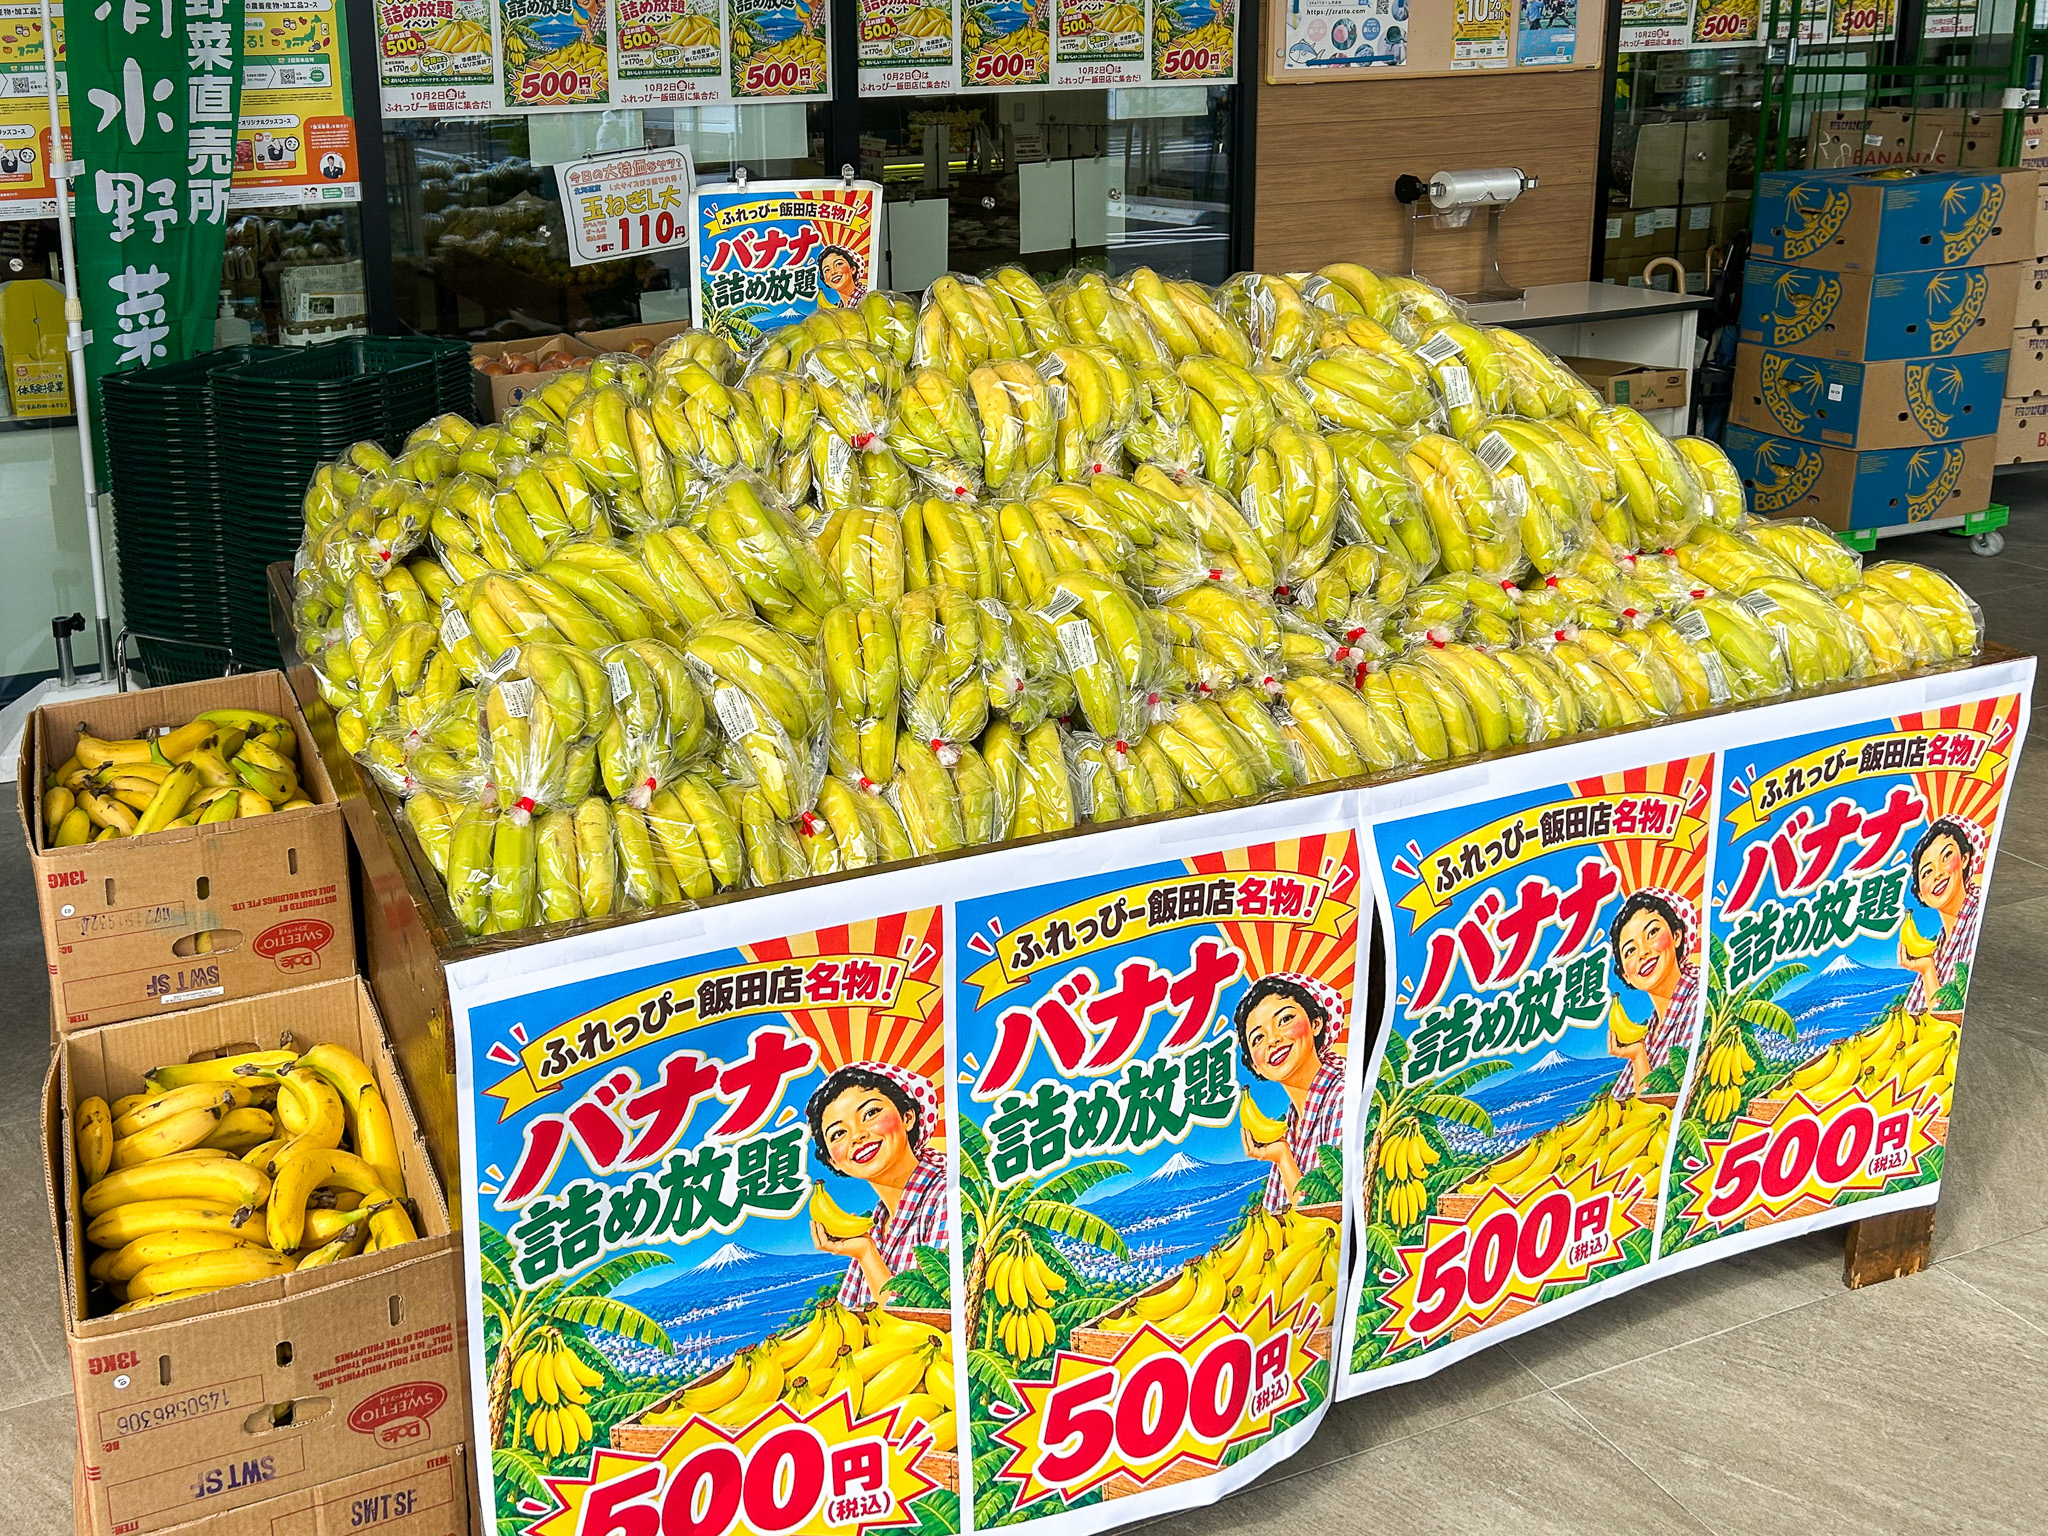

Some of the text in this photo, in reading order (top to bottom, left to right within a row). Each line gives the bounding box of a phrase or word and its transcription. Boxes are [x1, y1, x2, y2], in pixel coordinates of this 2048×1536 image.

[382, 1, 454, 26] 詰め放題
[402, 19, 439, 29] イベント
[620, 0, 686, 21] 詰め放題
[639, 13, 672, 23] イベント
[879, 5, 910, 15] イベント
[864, 22, 897, 40] 500円
[1062, 18, 1093, 35] 500円
[1702, 13, 1748, 37] 500円
[386, 38, 425, 56] 500円
[623, 31, 658, 49] 500円
[975, 53, 1035, 79] 500円
[1163, 48, 1220, 73] 500円
[520, 70, 591, 98] 500円
[746, 62, 811, 90] 500円
[580, 184, 682, 223] 玉ねぎL大
[721, 201, 853, 226] ふれっぴー飯田店名物!
[618, 211, 686, 252] 110円
[1783, 191, 1850, 260] BanaBay
[1944, 183, 2004, 265] BanaBay
[709, 226, 821, 272] バナナ
[713, 265, 819, 308] 詰め放題
[1773, 279, 1841, 346] BanaBay
[1930, 273, 1988, 353] BanaBay
[1760, 353, 1805, 435] BanaBay
[1906, 365, 1949, 439] BanaBay
[1753, 451, 1824, 512] BanaBay
[1907, 448, 1964, 524] BanaBay
[1759, 734, 1986, 810] ふれっぴー飯田店名物!
[1436, 798, 1678, 893] ふれっぴー飯田店名物!
[1723, 789, 1925, 915] バナナ
[47, 870, 88, 889] 13KG
[300, 888, 317, 899] ASIA
[319, 884, 336, 896] DOLE
[262, 892, 300, 906] HOLDINGS
[279, 895, 337, 913] DISTRIBUTED BY
[1011, 878, 1321, 969] ふれっぴー飯田店名物!
[1411, 862, 1618, 1012] バナナ
[1727, 867, 1908, 990] 詰め放題
[263, 929, 323, 949] SWEETIO
[280, 955, 313, 969] Dole
[146, 973, 171, 998] SF
[176, 965, 220, 992] SWT
[67, 1013, 89, 1024] ITEM:
[540, 959, 897, 1078] ふれっぴー飯田店名物!
[978, 942, 1239, 1093] バナナ
[1408, 946, 1609, 1083] 詰め放題
[504, 1032, 815, 1201] バナナ
[990, 1036, 1238, 1183] 詰め放題
[1706, 1106, 1909, 1218] 500円
[1867, 1149, 1909, 1176] (税込)
[514, 1129, 805, 1286] 詰め放題
[1409, 1193, 1610, 1333] 500円
[1568, 1233, 1611, 1266] (税込)
[334, 1322, 452, 1364] PRODUCE OF THE PHILIPPINES
[361, 1345, 409, 1366] Registered
[421, 1344, 453, 1359] PACKED
[88, 1350, 142, 1376] 13KG
[313, 1357, 361, 1382] Trademark
[387, 1355, 409, 1370] DOLE
[409, 1353, 421, 1363] BY
[360, 1392, 434, 1423] SWEETIO
[1037, 1332, 1291, 1482] 500円
[1250, 1373, 1291, 1419] (税込)
[381, 1423, 421, 1443] Dole
[426, 1454, 451, 1469] ITEM:
[189, 1455, 277, 1499] SWT SF
[574, 1430, 883, 1536] 500円
[351, 1488, 418, 1527] SWT SF
[826, 1491, 893, 1523] (税込)
[111, 1520, 139, 1536] ITEM:
